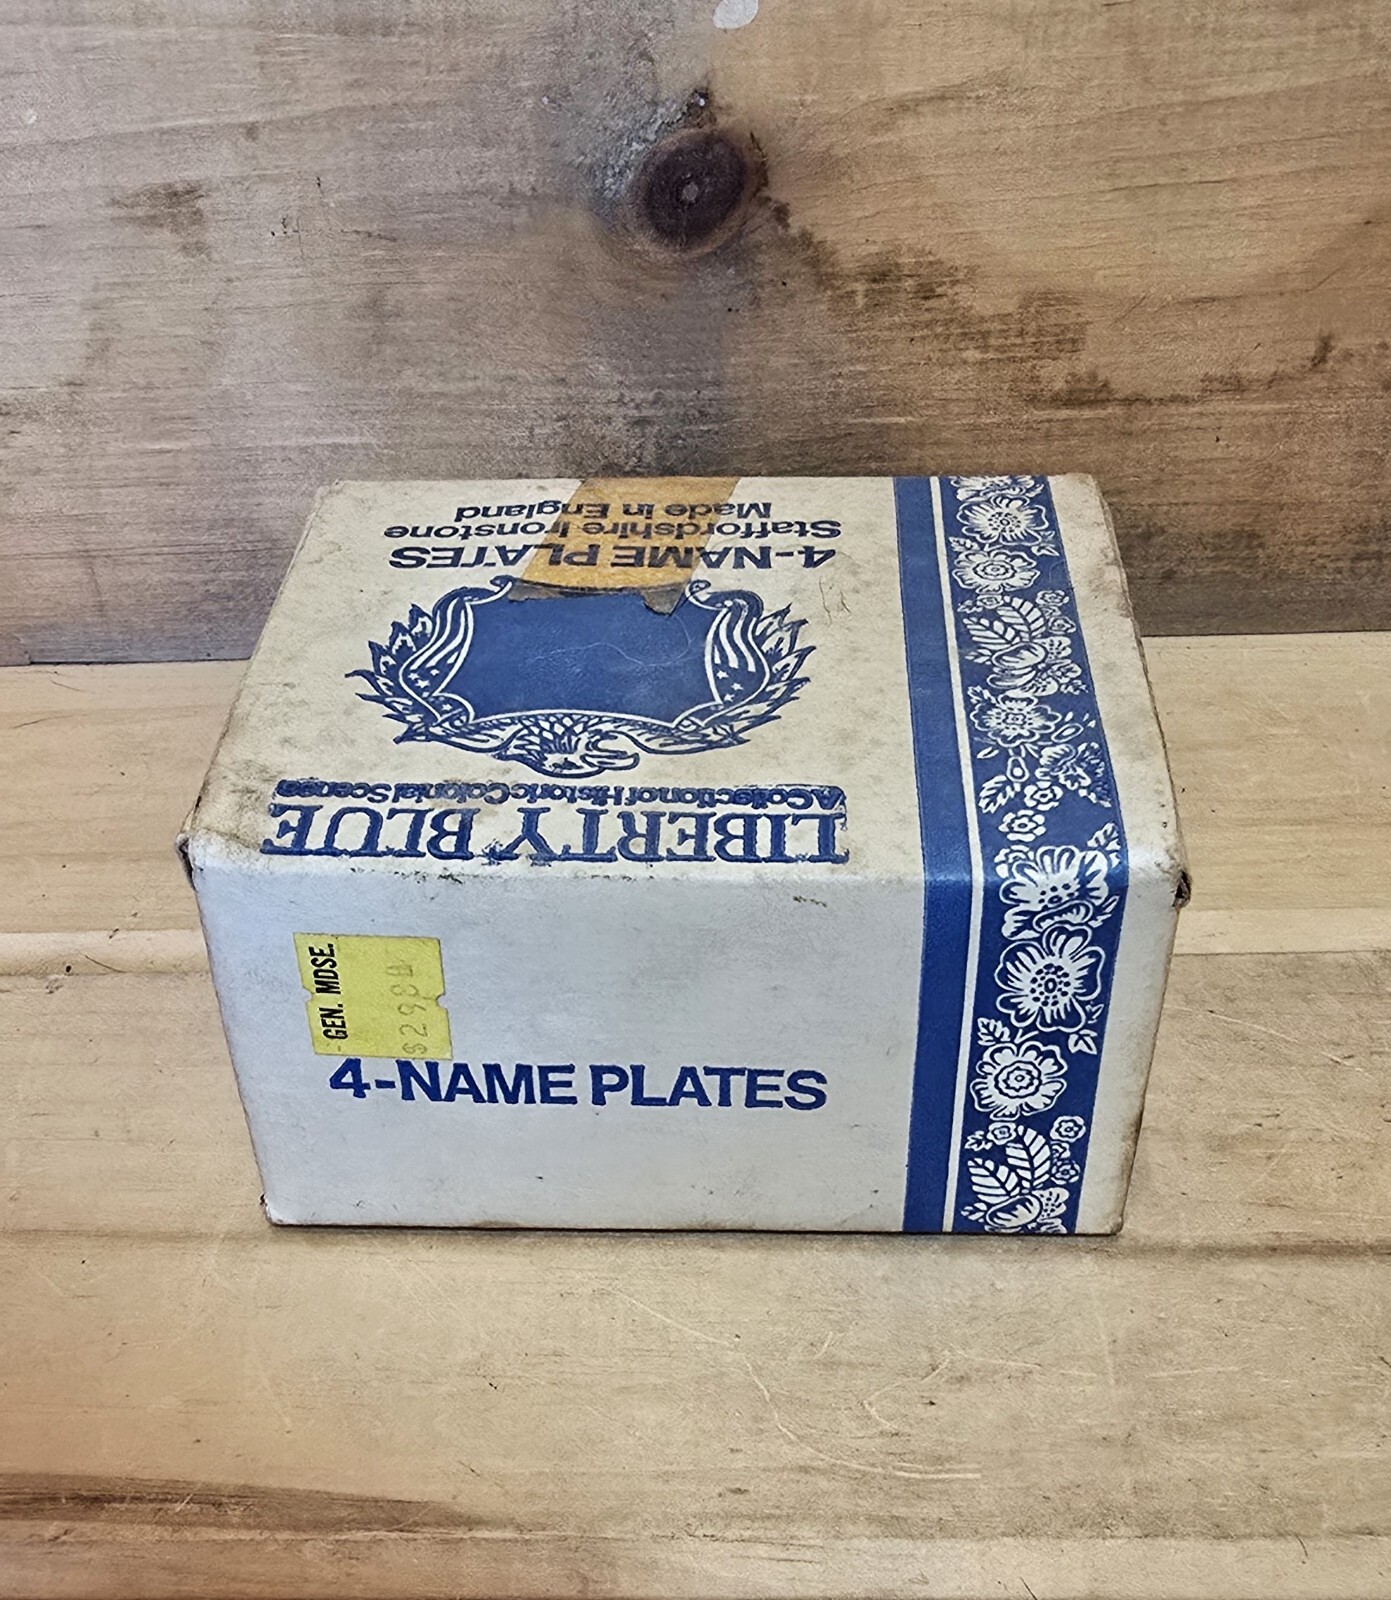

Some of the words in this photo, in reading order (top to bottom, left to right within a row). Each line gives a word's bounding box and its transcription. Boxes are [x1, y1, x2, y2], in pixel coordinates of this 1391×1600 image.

[454, 500, 611, 522] England
[622, 502, 655, 519] in
[665, 501, 772, 519] Made
[383, 520, 568, 540] Ironstone
[582, 519, 841, 540] Staffordshire
[389, 543, 601, 569] PLATES
[611, 545, 836, 569] 4-NAME
[260, 802, 482, 861] BLUE
[503, 806, 849, 864] LIBERTY
[308, 943, 342, 995] MDSE.
[319, 1002, 349, 1040] GEN.
[329, 1057, 578, 1107] 4-NAME
[589, 1063, 829, 1111] PLATES
